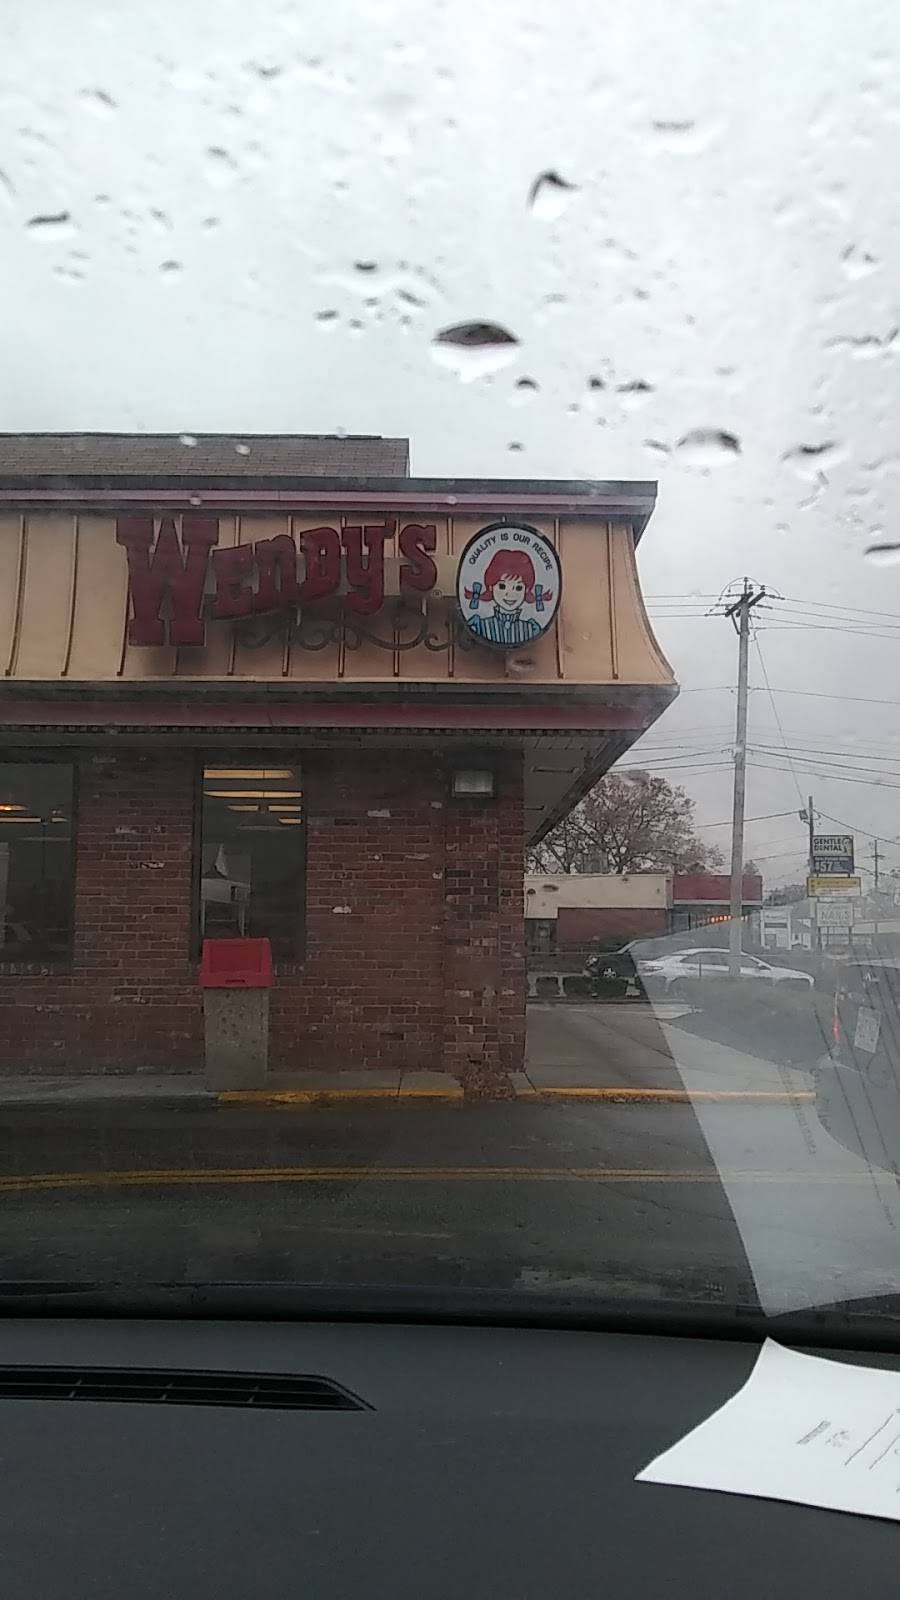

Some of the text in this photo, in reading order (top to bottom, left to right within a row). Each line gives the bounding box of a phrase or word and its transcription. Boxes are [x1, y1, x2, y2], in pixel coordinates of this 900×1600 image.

[468, 532, 553, 571] QUALITY IS OUR RECIPE
